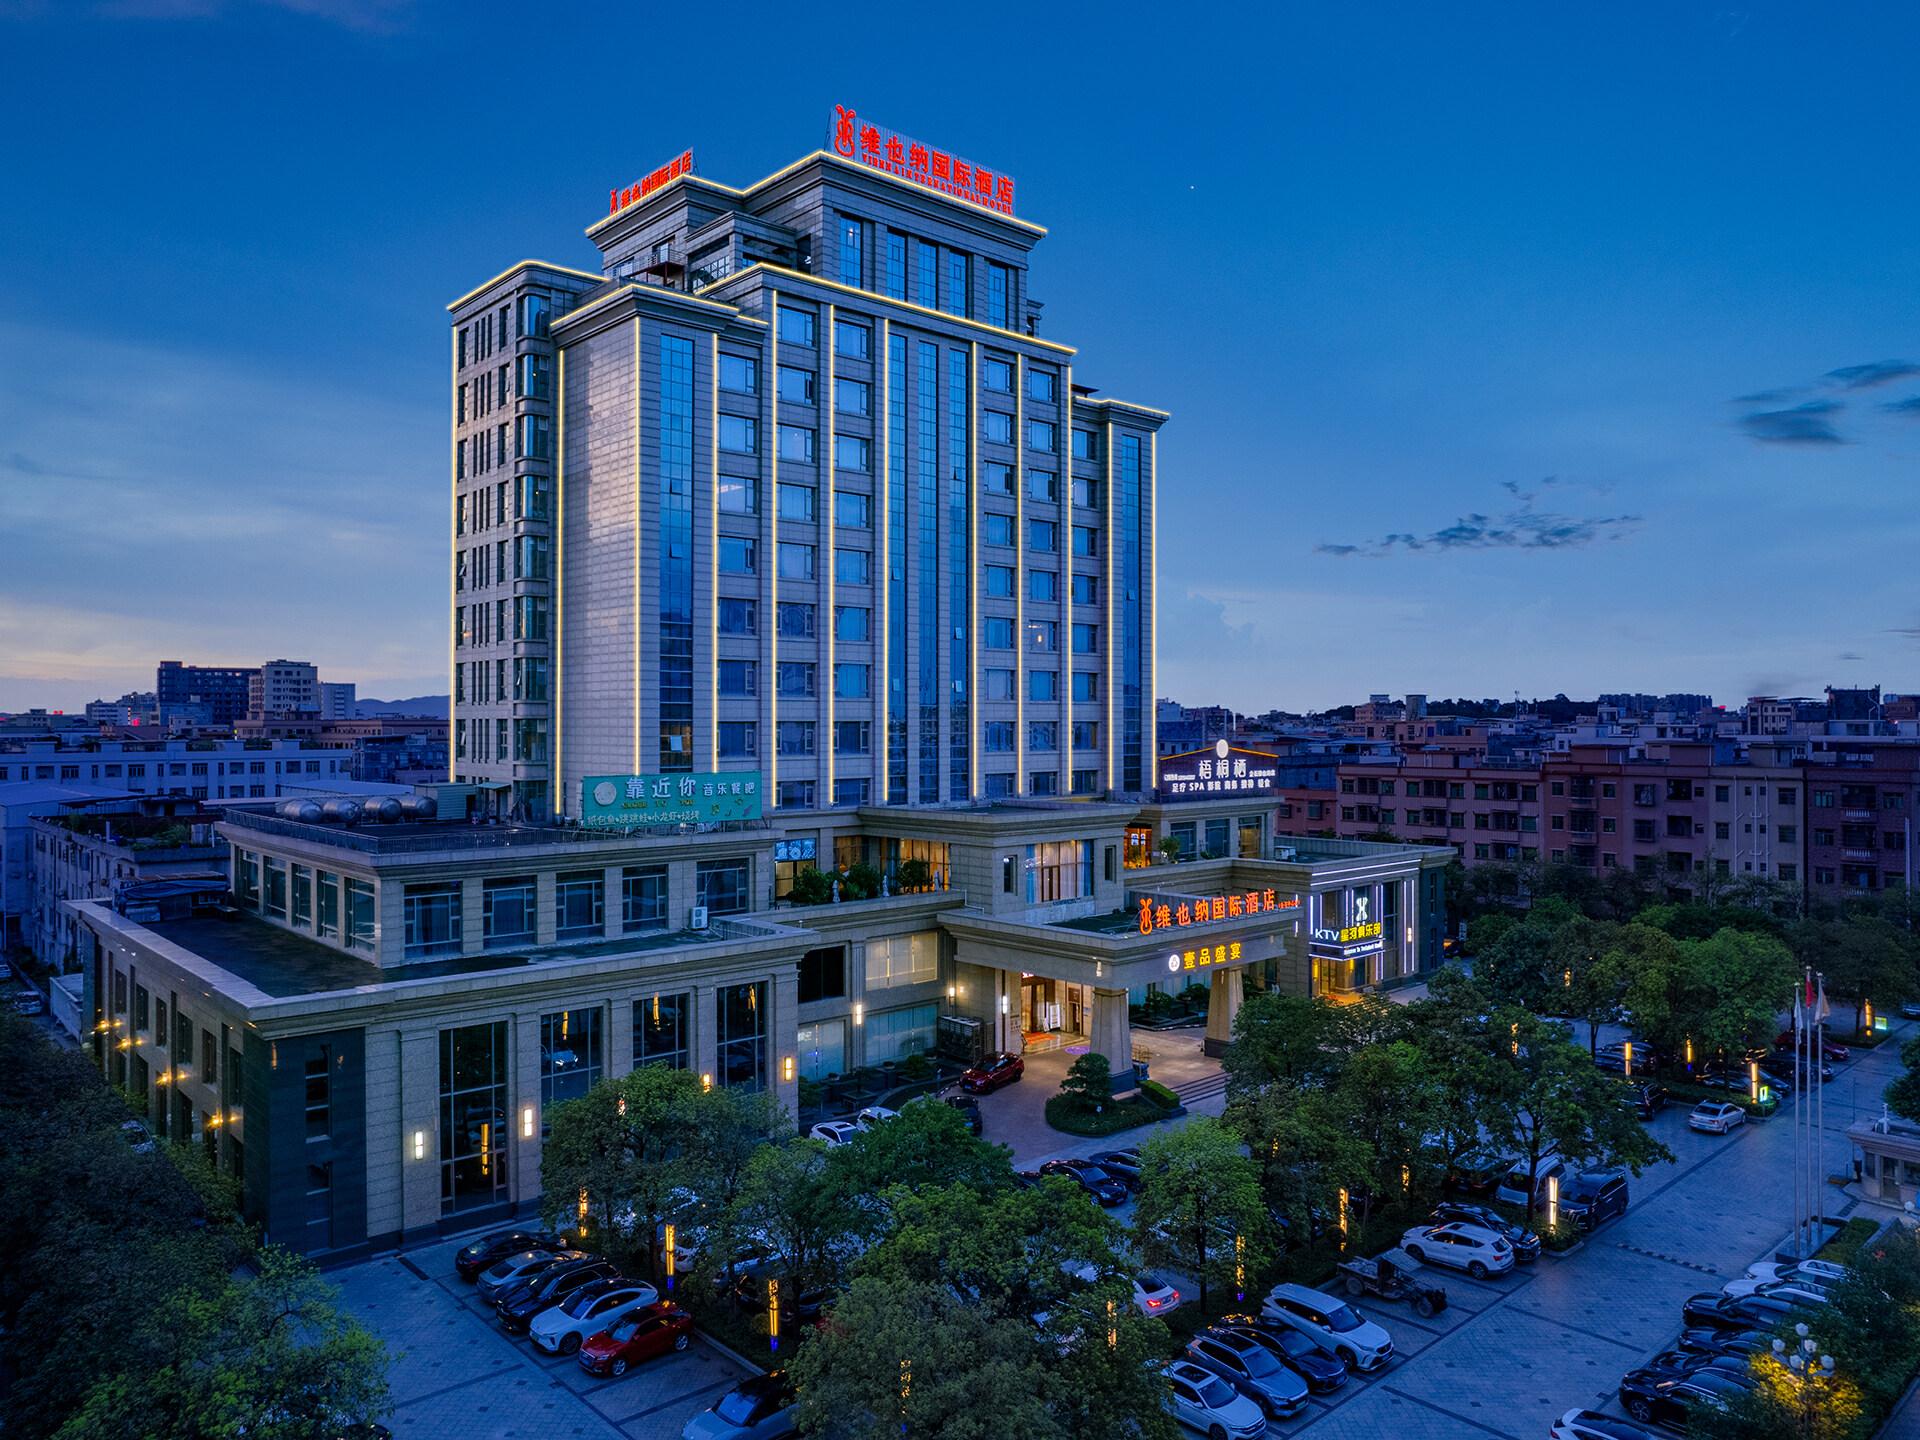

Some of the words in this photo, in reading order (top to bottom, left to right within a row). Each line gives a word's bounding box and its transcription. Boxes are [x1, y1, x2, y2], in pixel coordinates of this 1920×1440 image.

[860, 123, 1014, 205] 维也纳国际酒店
[620, 150, 692, 208] 维也纳国际酒店
[625, 776, 696, 799] 靠近你
[703, 781, 755, 797] 音乐餐吧
[1189, 781, 1205, 792] SPA
[1156, 888, 1276, 928] 维也纳国际酒店
[1315, 928, 1340, 941] KTV
[1340, 922, 1381, 943] 星河俱乐部
[1184, 942, 1241, 970] 壹品盛宴
